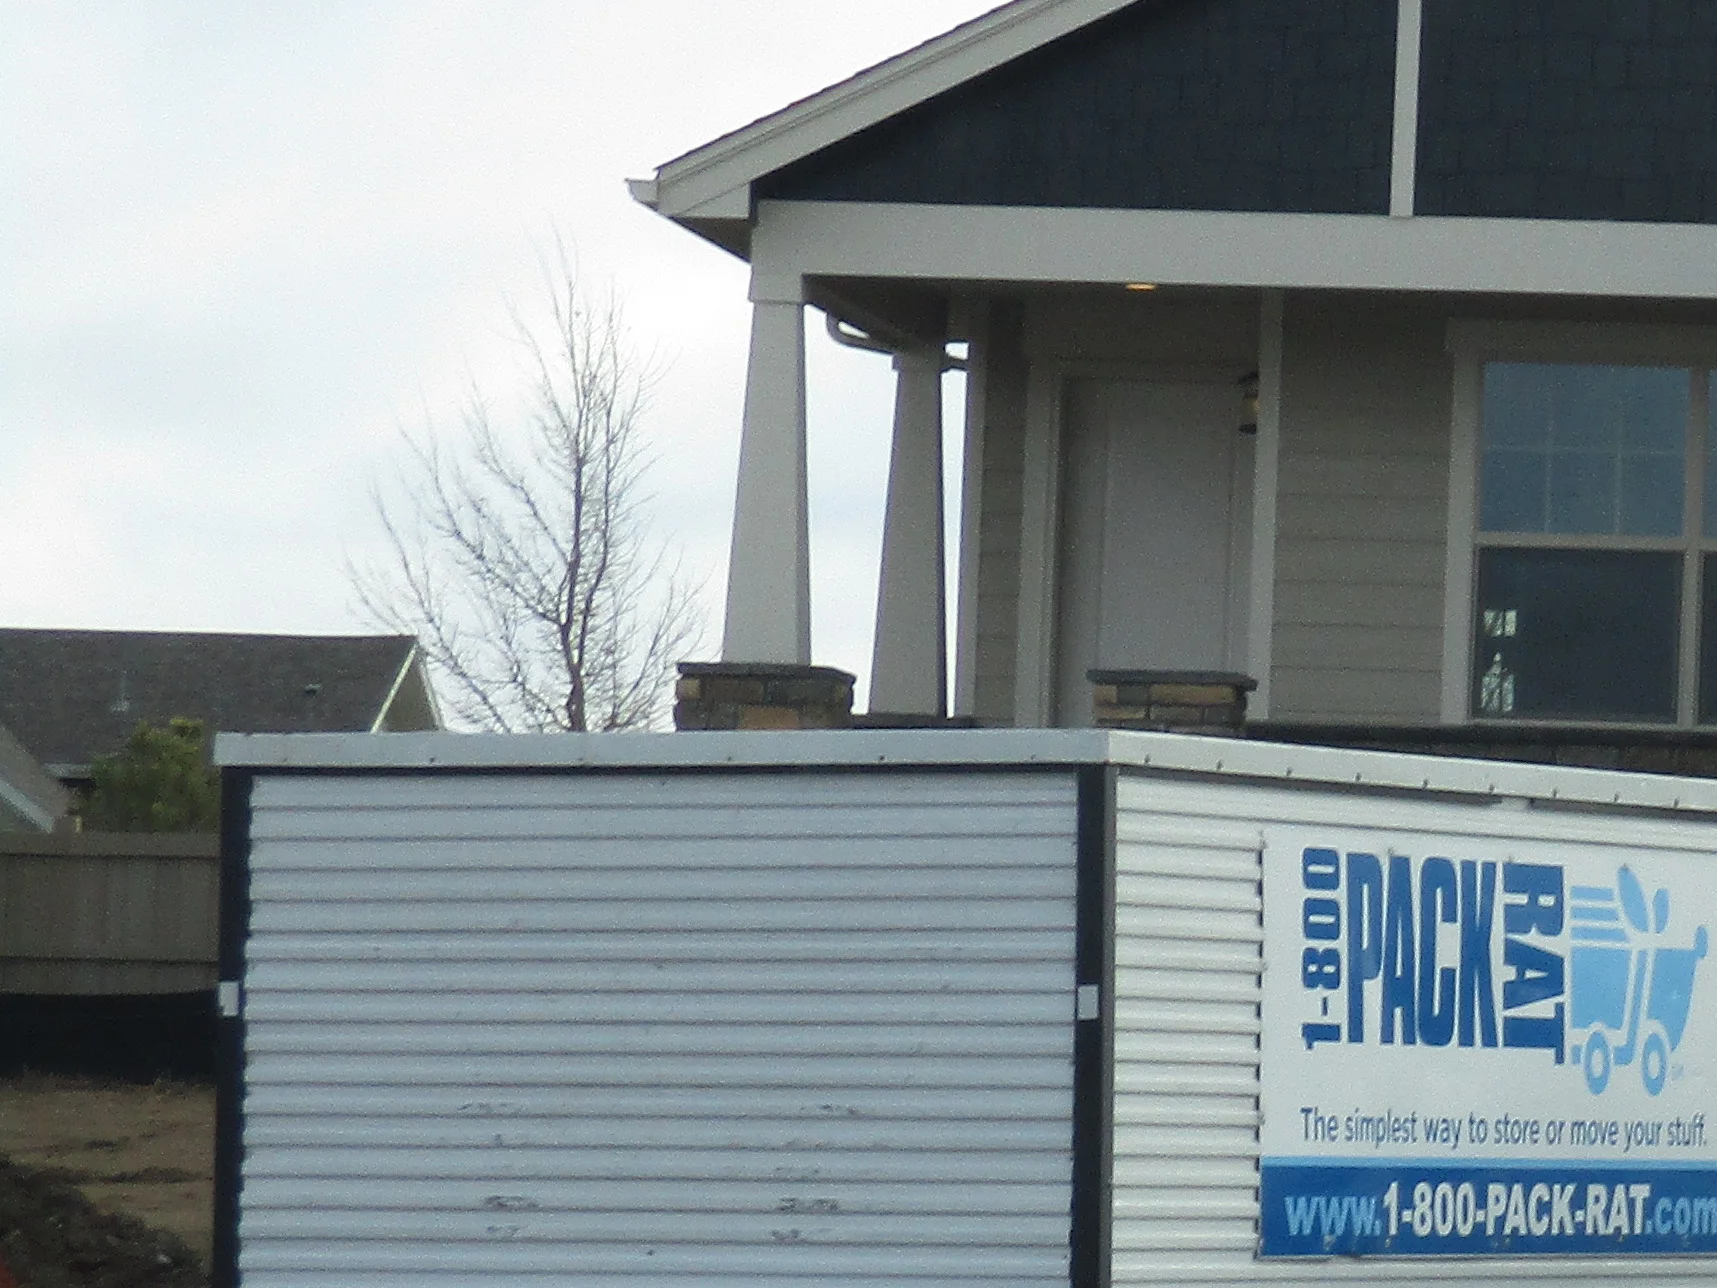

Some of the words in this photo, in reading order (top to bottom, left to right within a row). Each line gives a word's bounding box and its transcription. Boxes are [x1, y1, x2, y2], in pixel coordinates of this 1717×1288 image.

[1301, 847, 1341, 1050] 1-800
[1346, 851, 1497, 1048] PACK
[1503, 863, 1565, 1064] RAT
[1300, 1107, 1339, 1142] The
[1344, 1108, 1417, 1148] simplest
[1423, 1115, 1462, 1150] way
[1468, 1112, 1488, 1144] to
[1494, 1113, 1540, 1144] store
[1546, 1119, 1565, 1145] or
[1570, 1120, 1619, 1146] move
[1624, 1121, 1662, 1153] your
[1667, 1113, 1707, 1147] stuff.
